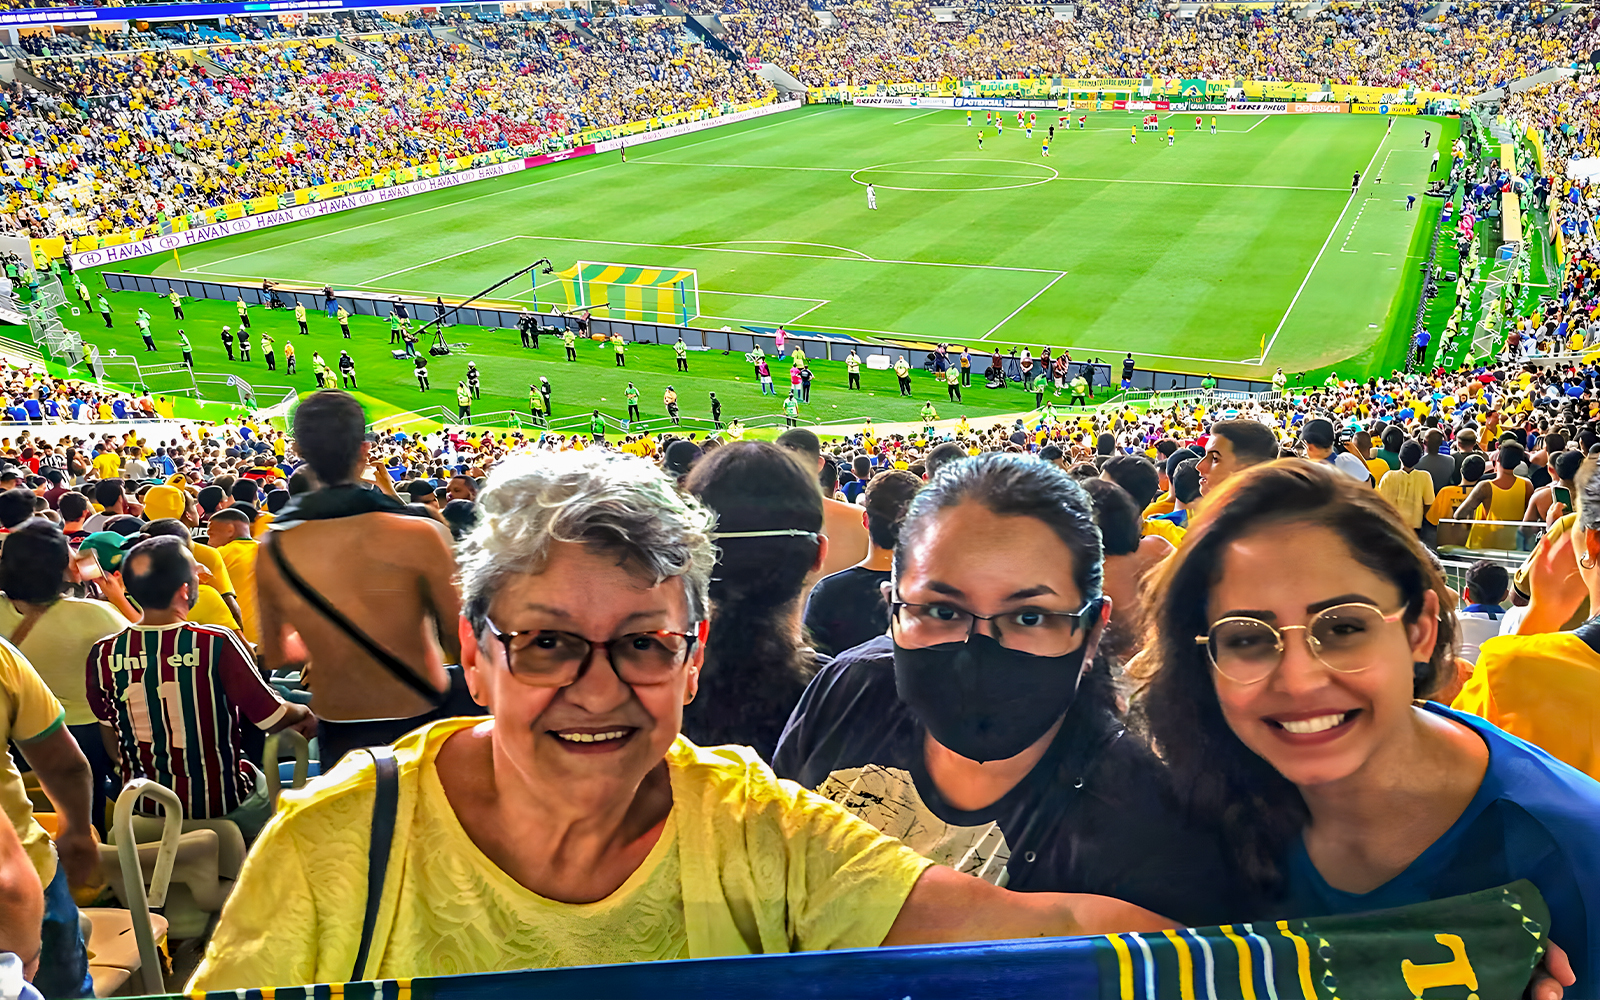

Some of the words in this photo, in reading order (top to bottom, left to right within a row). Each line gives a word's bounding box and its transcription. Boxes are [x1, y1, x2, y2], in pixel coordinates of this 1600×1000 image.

[106, 240, 153, 261] HAVAN
[184, 222, 230, 244] HAVAN
[256, 209, 294, 228] HAVAN
[319, 196, 357, 214] HAVAN
[379, 186, 410, 201] HAVAN
[429, 170, 460, 189] HAVAN
[479, 165, 504, 179] HAVAN
[107, 648, 200, 672] Unied
[120, 681, 184, 749] 11
